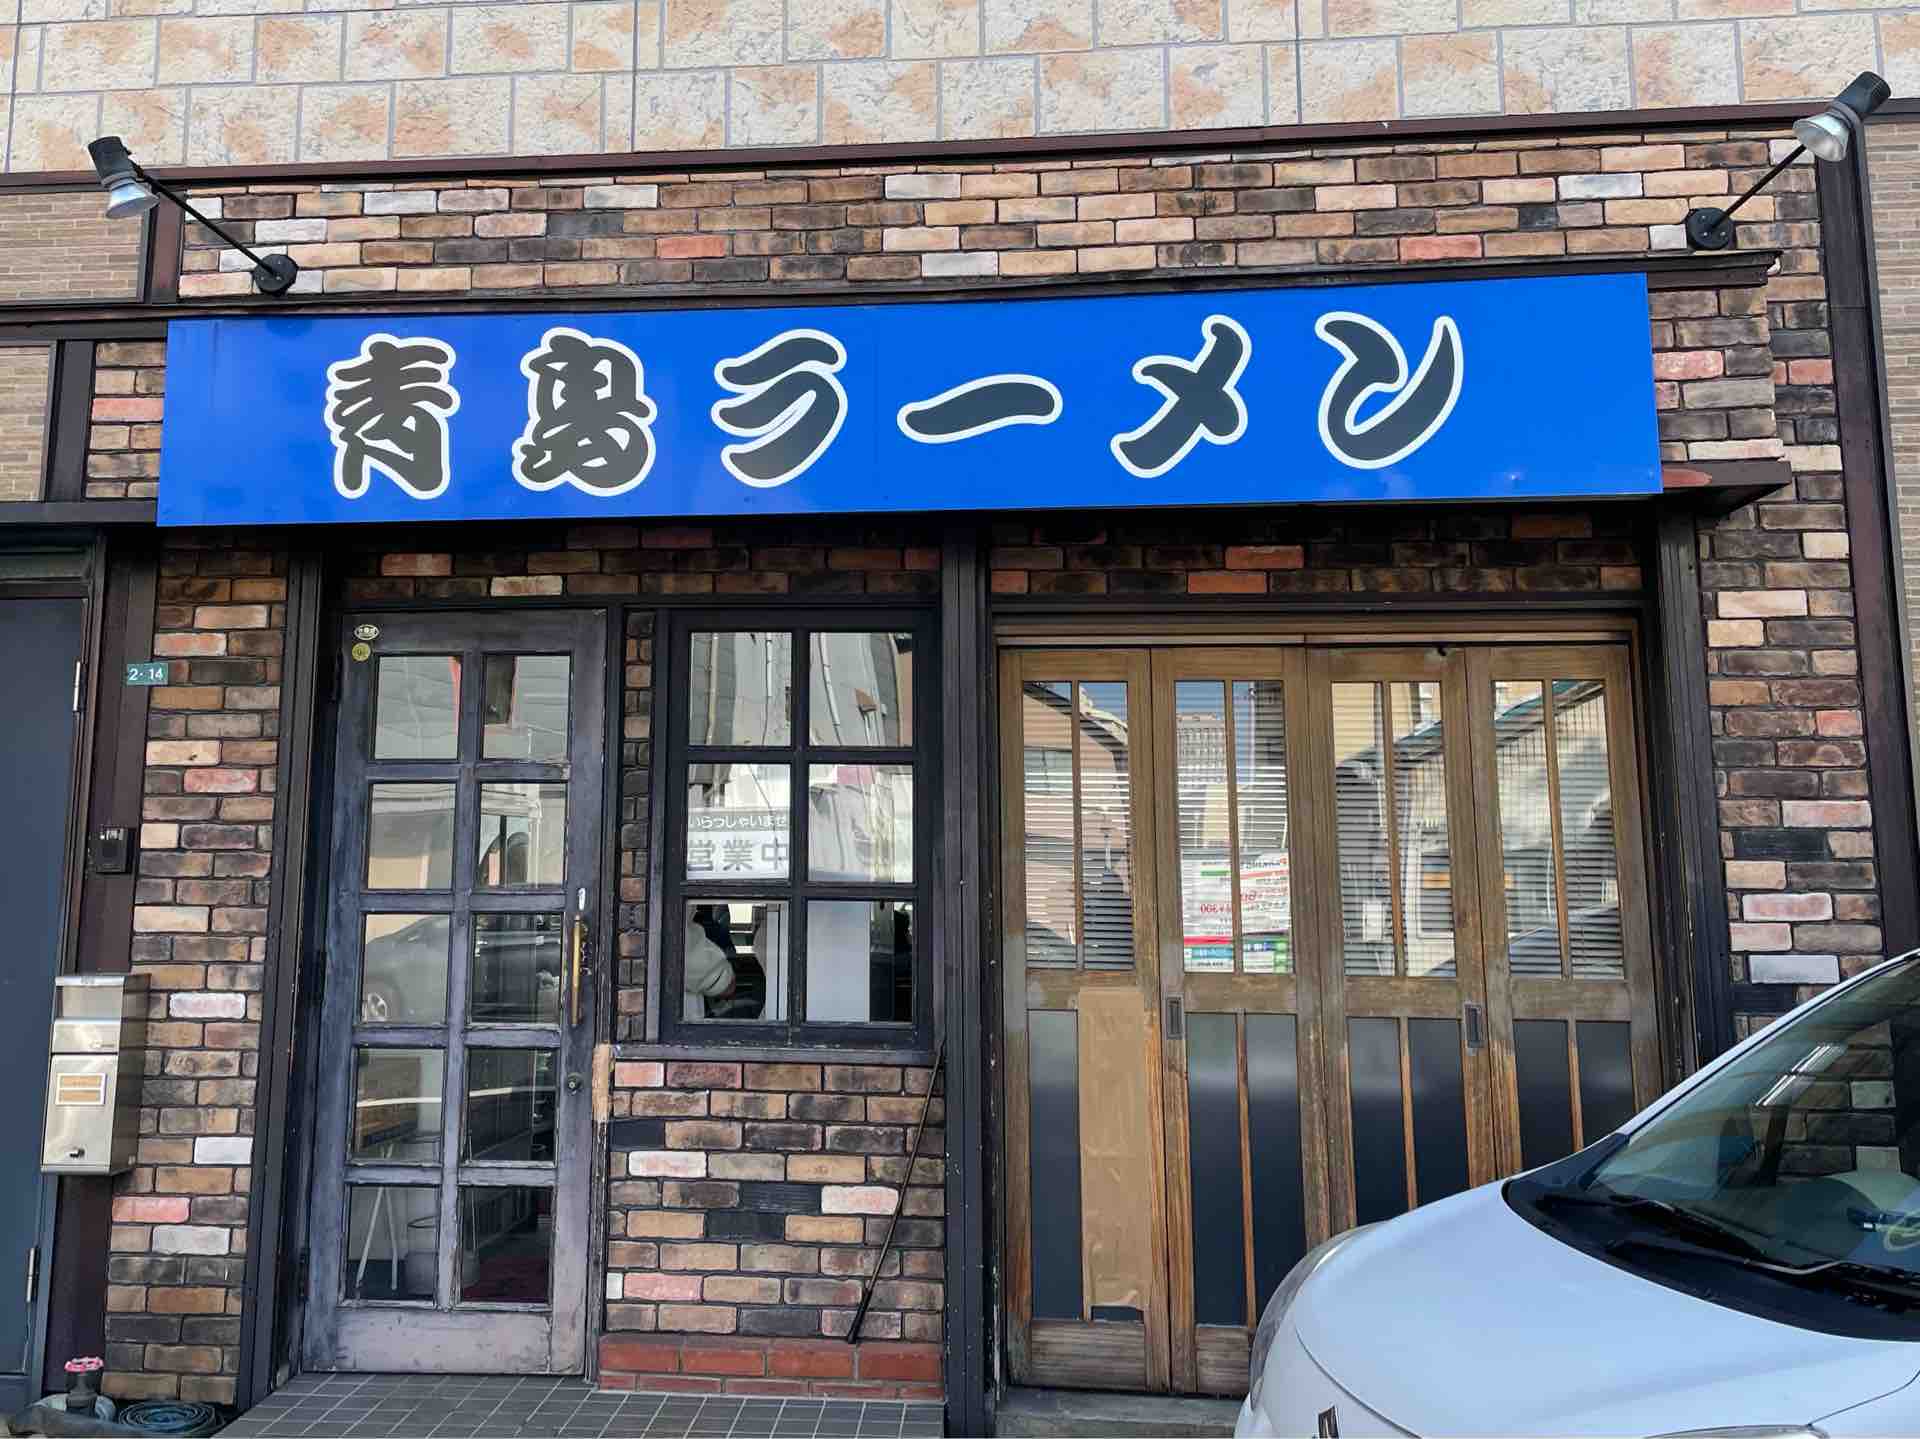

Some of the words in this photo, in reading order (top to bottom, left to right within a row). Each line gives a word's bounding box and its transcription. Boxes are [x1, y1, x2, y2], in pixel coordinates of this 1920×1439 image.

[324, 312, 1465, 500] 青島ラーメン
[687, 836, 789, 872] 営業中
